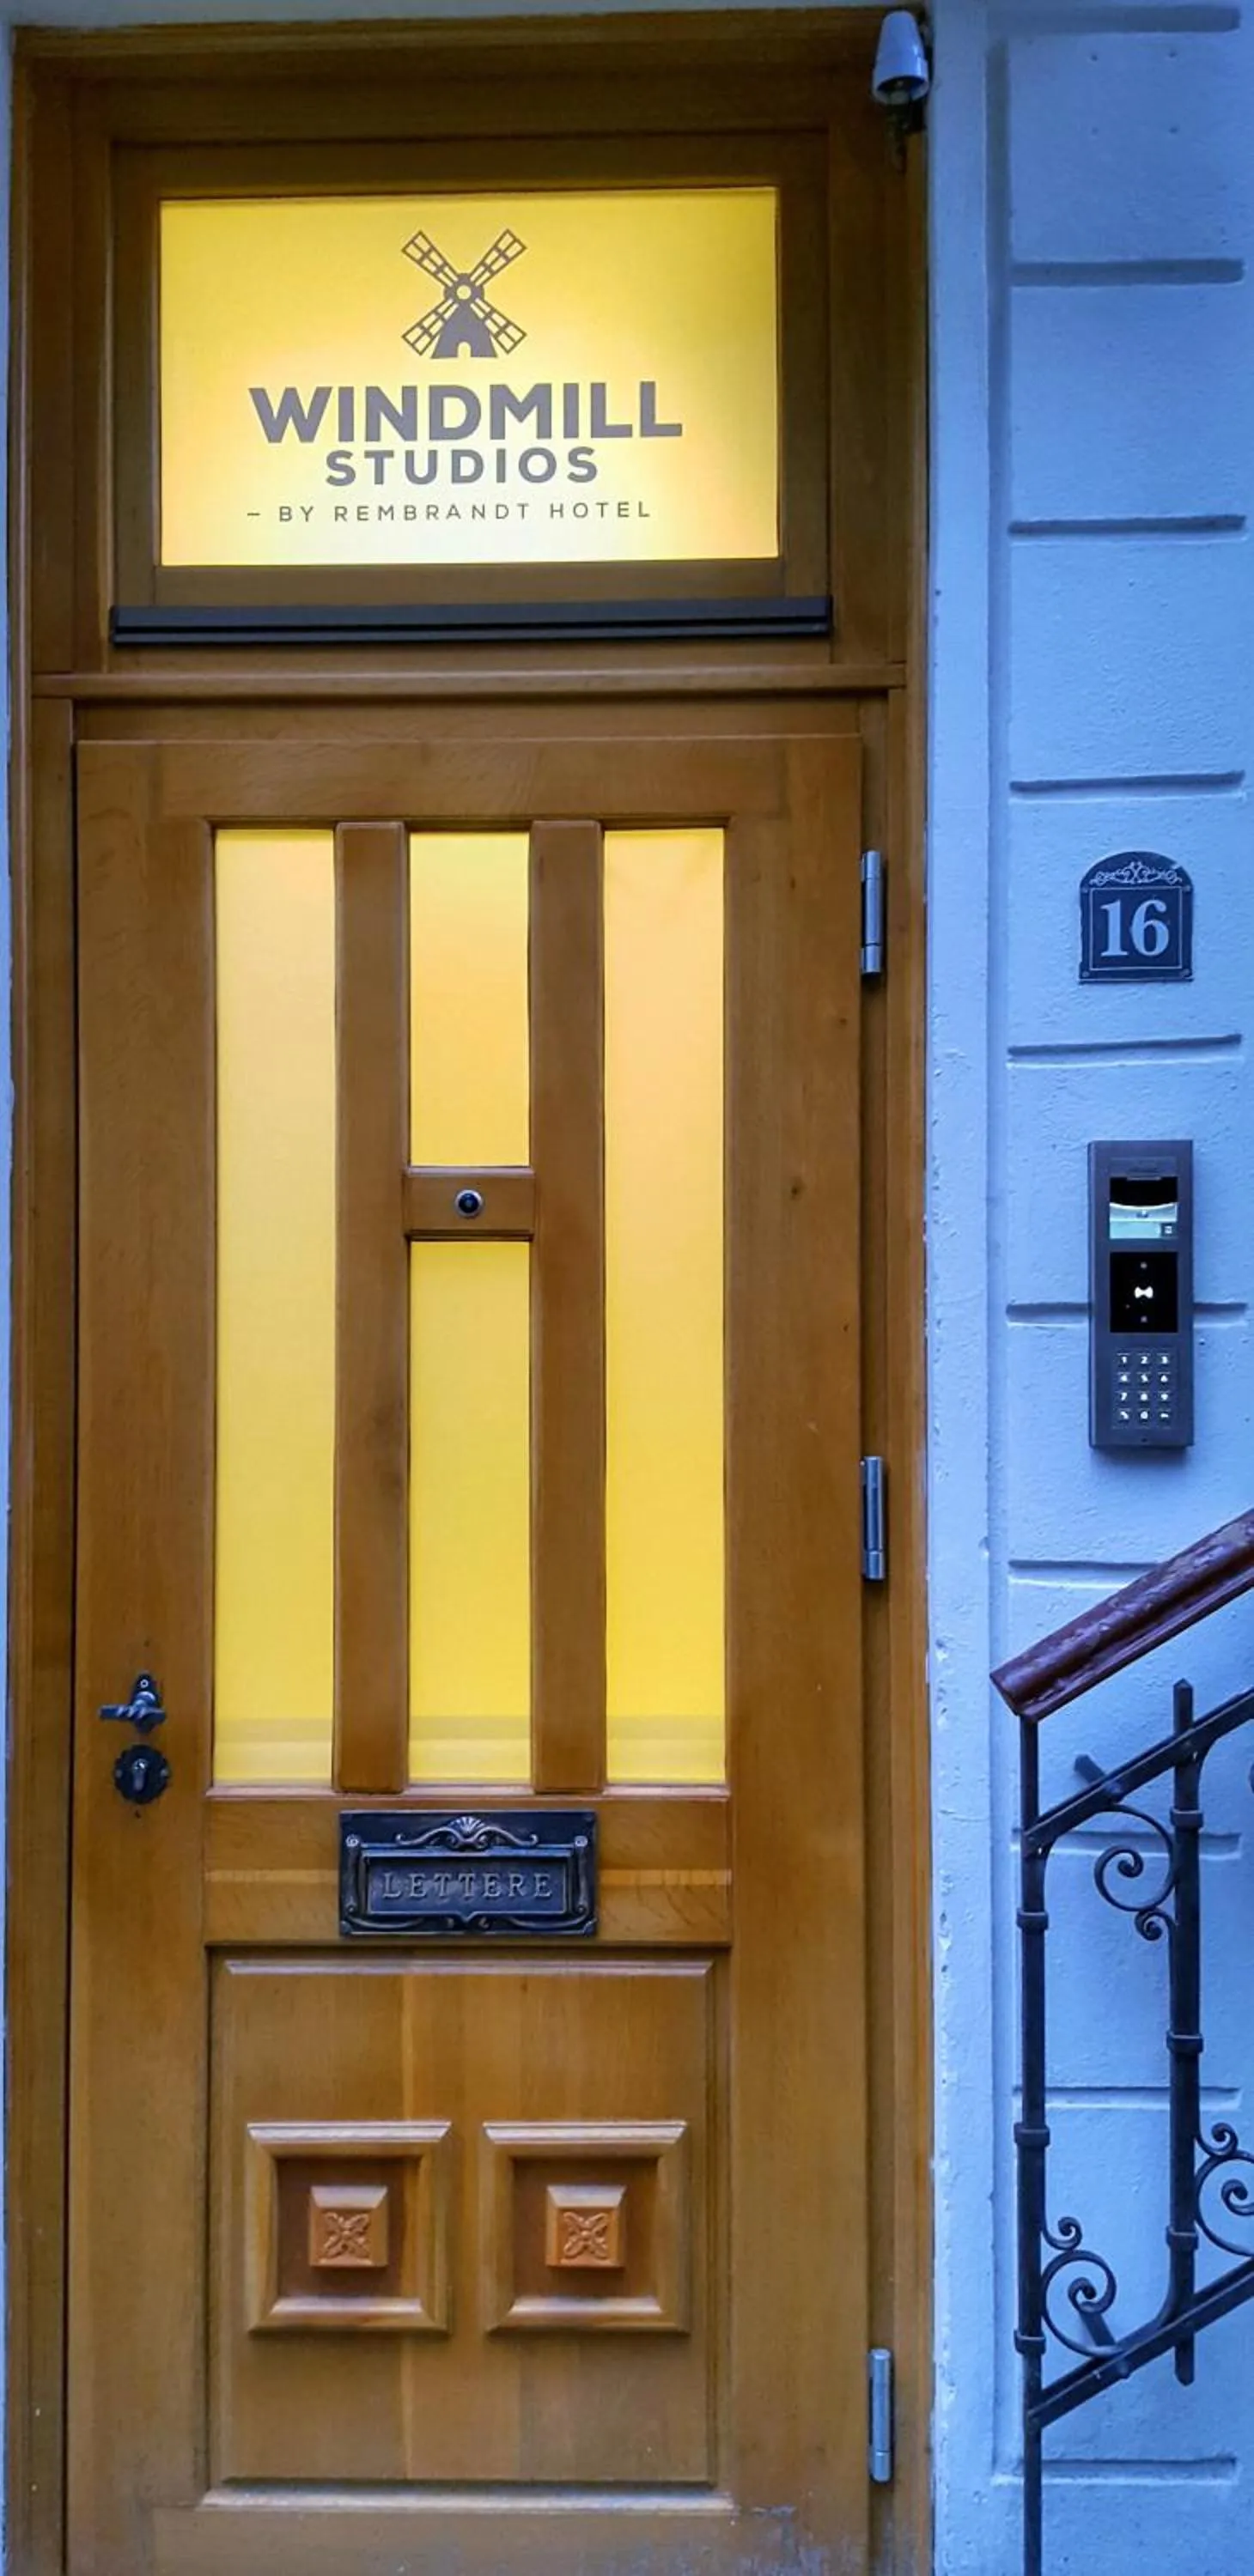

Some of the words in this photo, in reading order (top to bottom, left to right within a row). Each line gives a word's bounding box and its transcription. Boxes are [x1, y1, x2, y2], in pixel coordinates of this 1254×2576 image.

[248, 381, 683, 443] WINDMILL
[326, 446, 598, 487] STUDIOS
[279, 506, 314, 522] BY
[334, 503, 529, 521] REMBRANDT
[550, 501, 650, 519] HOTEL
[1100, 899, 1170, 957] 16
[382, 1872, 551, 1898] LETTERE
